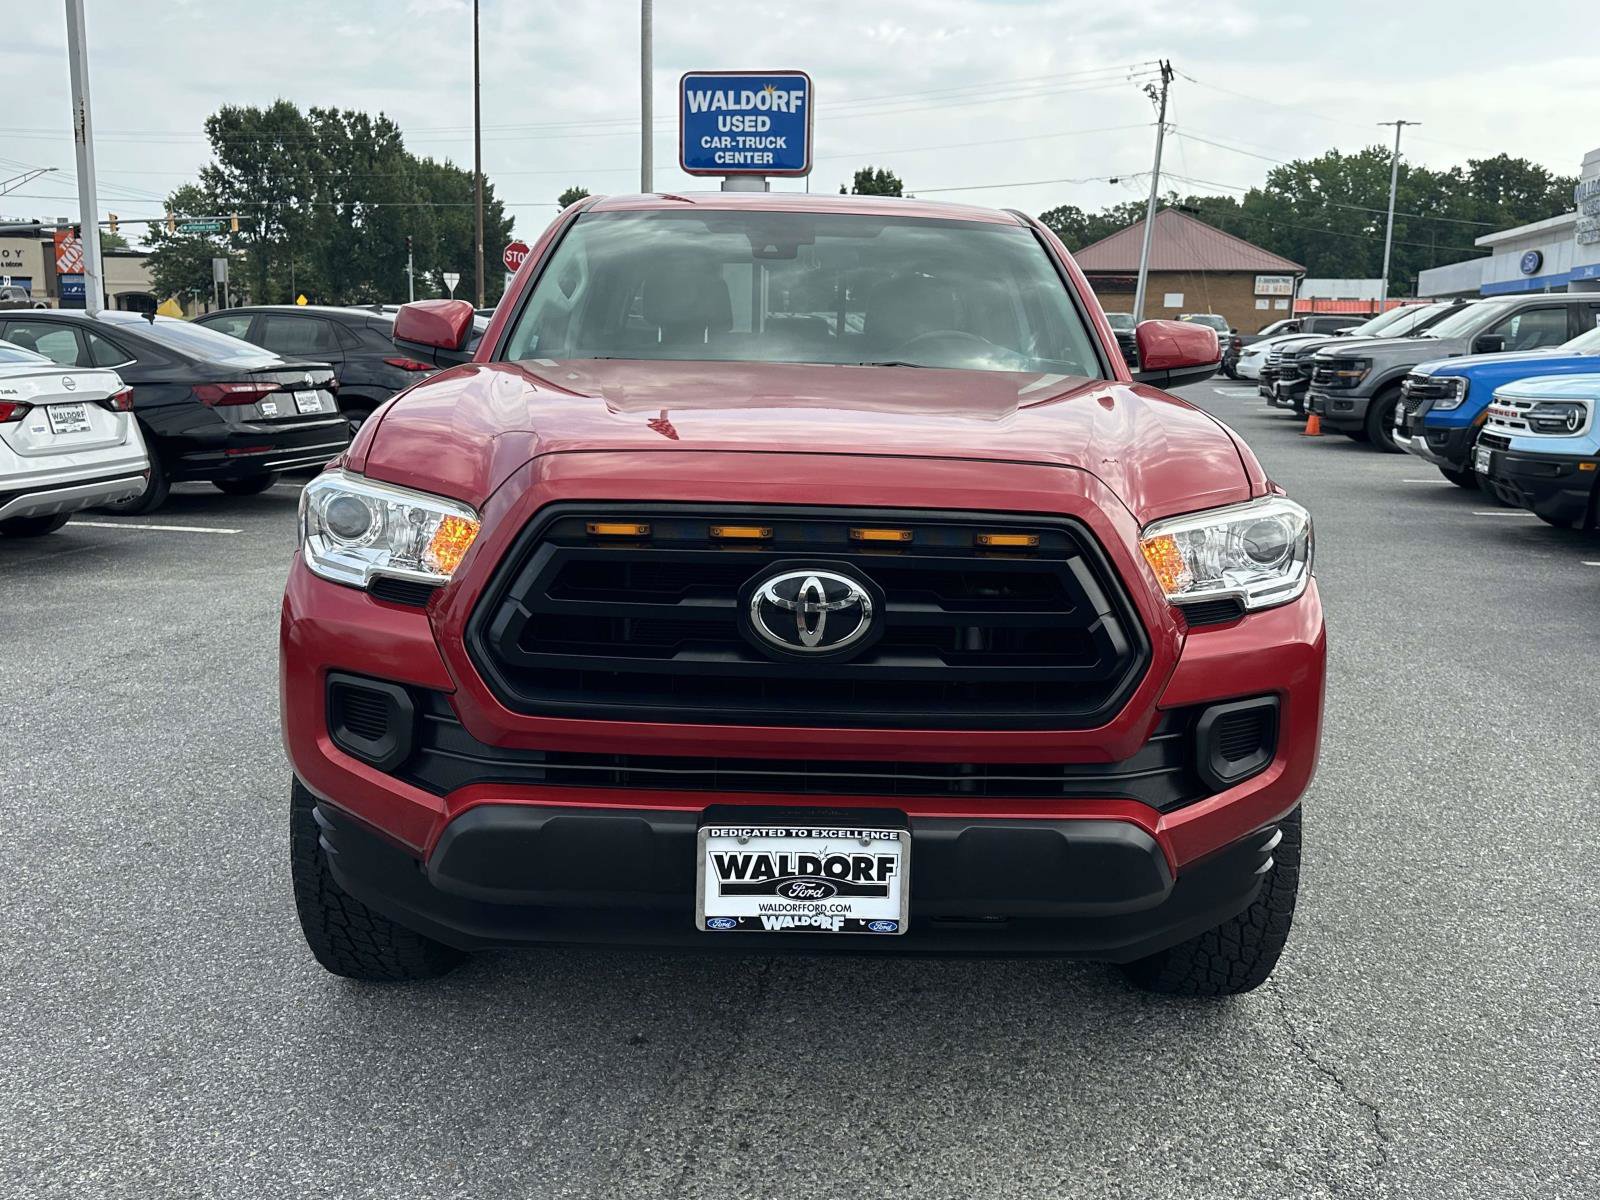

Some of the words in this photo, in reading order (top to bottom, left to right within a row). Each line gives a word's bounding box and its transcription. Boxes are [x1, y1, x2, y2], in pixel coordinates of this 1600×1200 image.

[687, 90, 804, 113] WALDORF
[718, 115, 771, 132] USED
[701, 136, 787, 149] CAR-TRUCK
[714, 152, 773, 164] CENTER
[505, 250, 527, 263] STO
[711, 829, 786, 838] DEDICATED
[812, 830, 898, 840] EXCELLENCE
[713, 853, 896, 883] WALDORF
[788, 882, 825, 899] Ford
[758, 903, 852, 913] WALDORFFORD.COM
[712, 918, 733, 928] Ford
[760, 914, 846, 931] WALDORF
[874, 921, 895, 931] Ford
